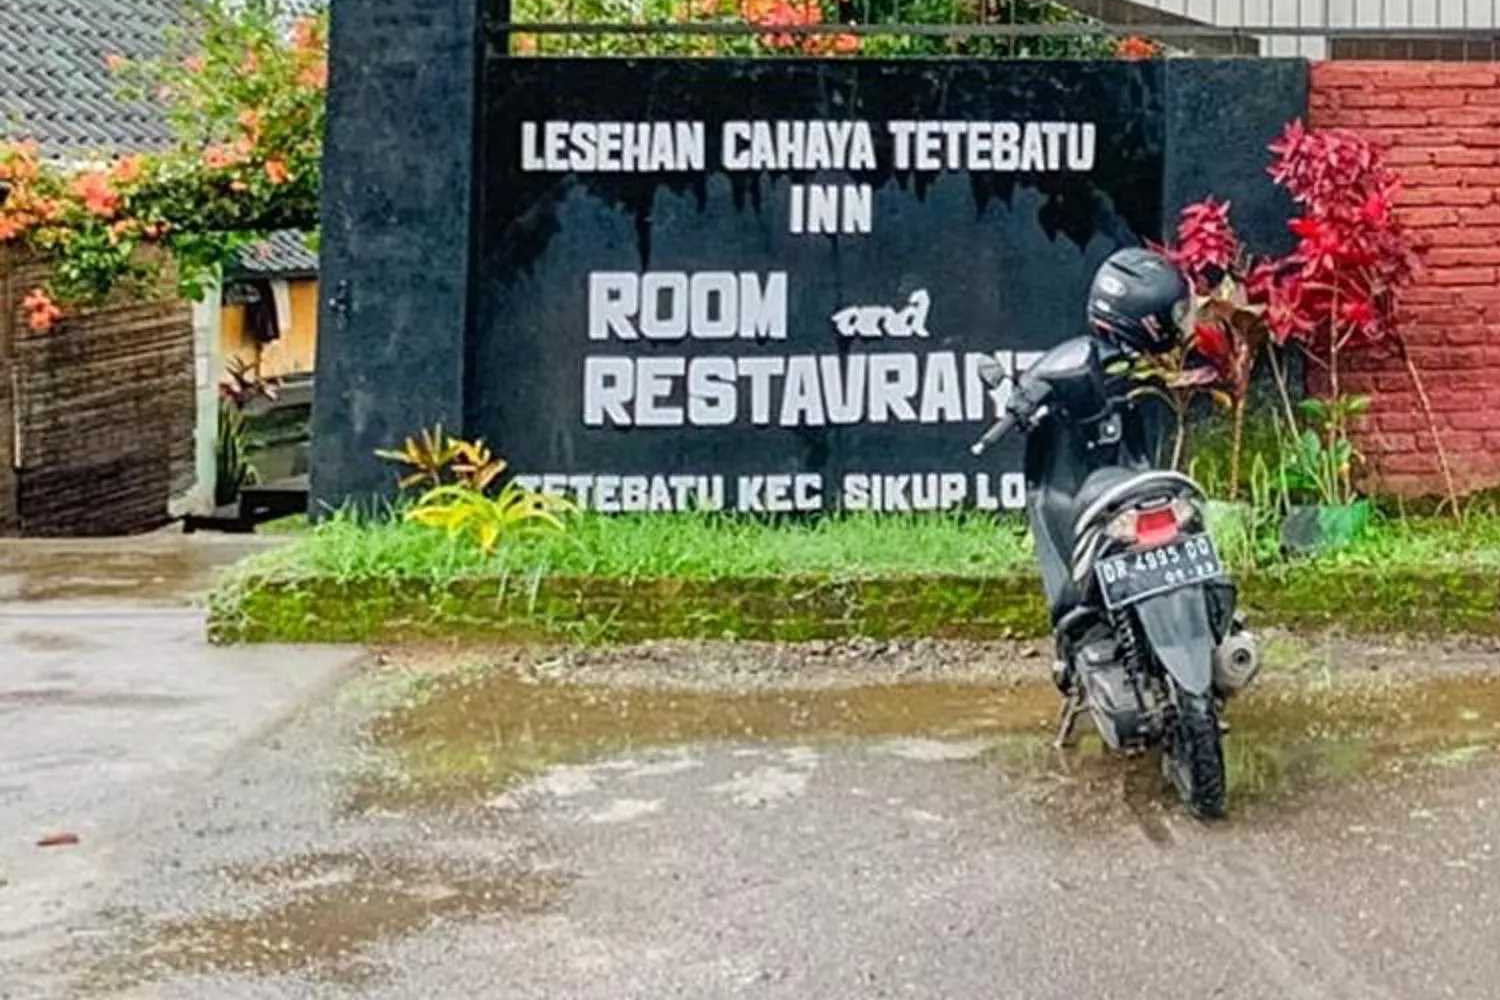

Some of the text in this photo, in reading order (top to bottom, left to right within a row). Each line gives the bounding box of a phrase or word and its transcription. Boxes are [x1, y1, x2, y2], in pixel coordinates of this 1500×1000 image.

[521, 120, 1097, 172] LESEHAN CAHAYA TETEBATU
[789, 184, 873, 235] INN
[587, 271, 931, 340] ROOM and
[737, 474, 823, 512] KEC
